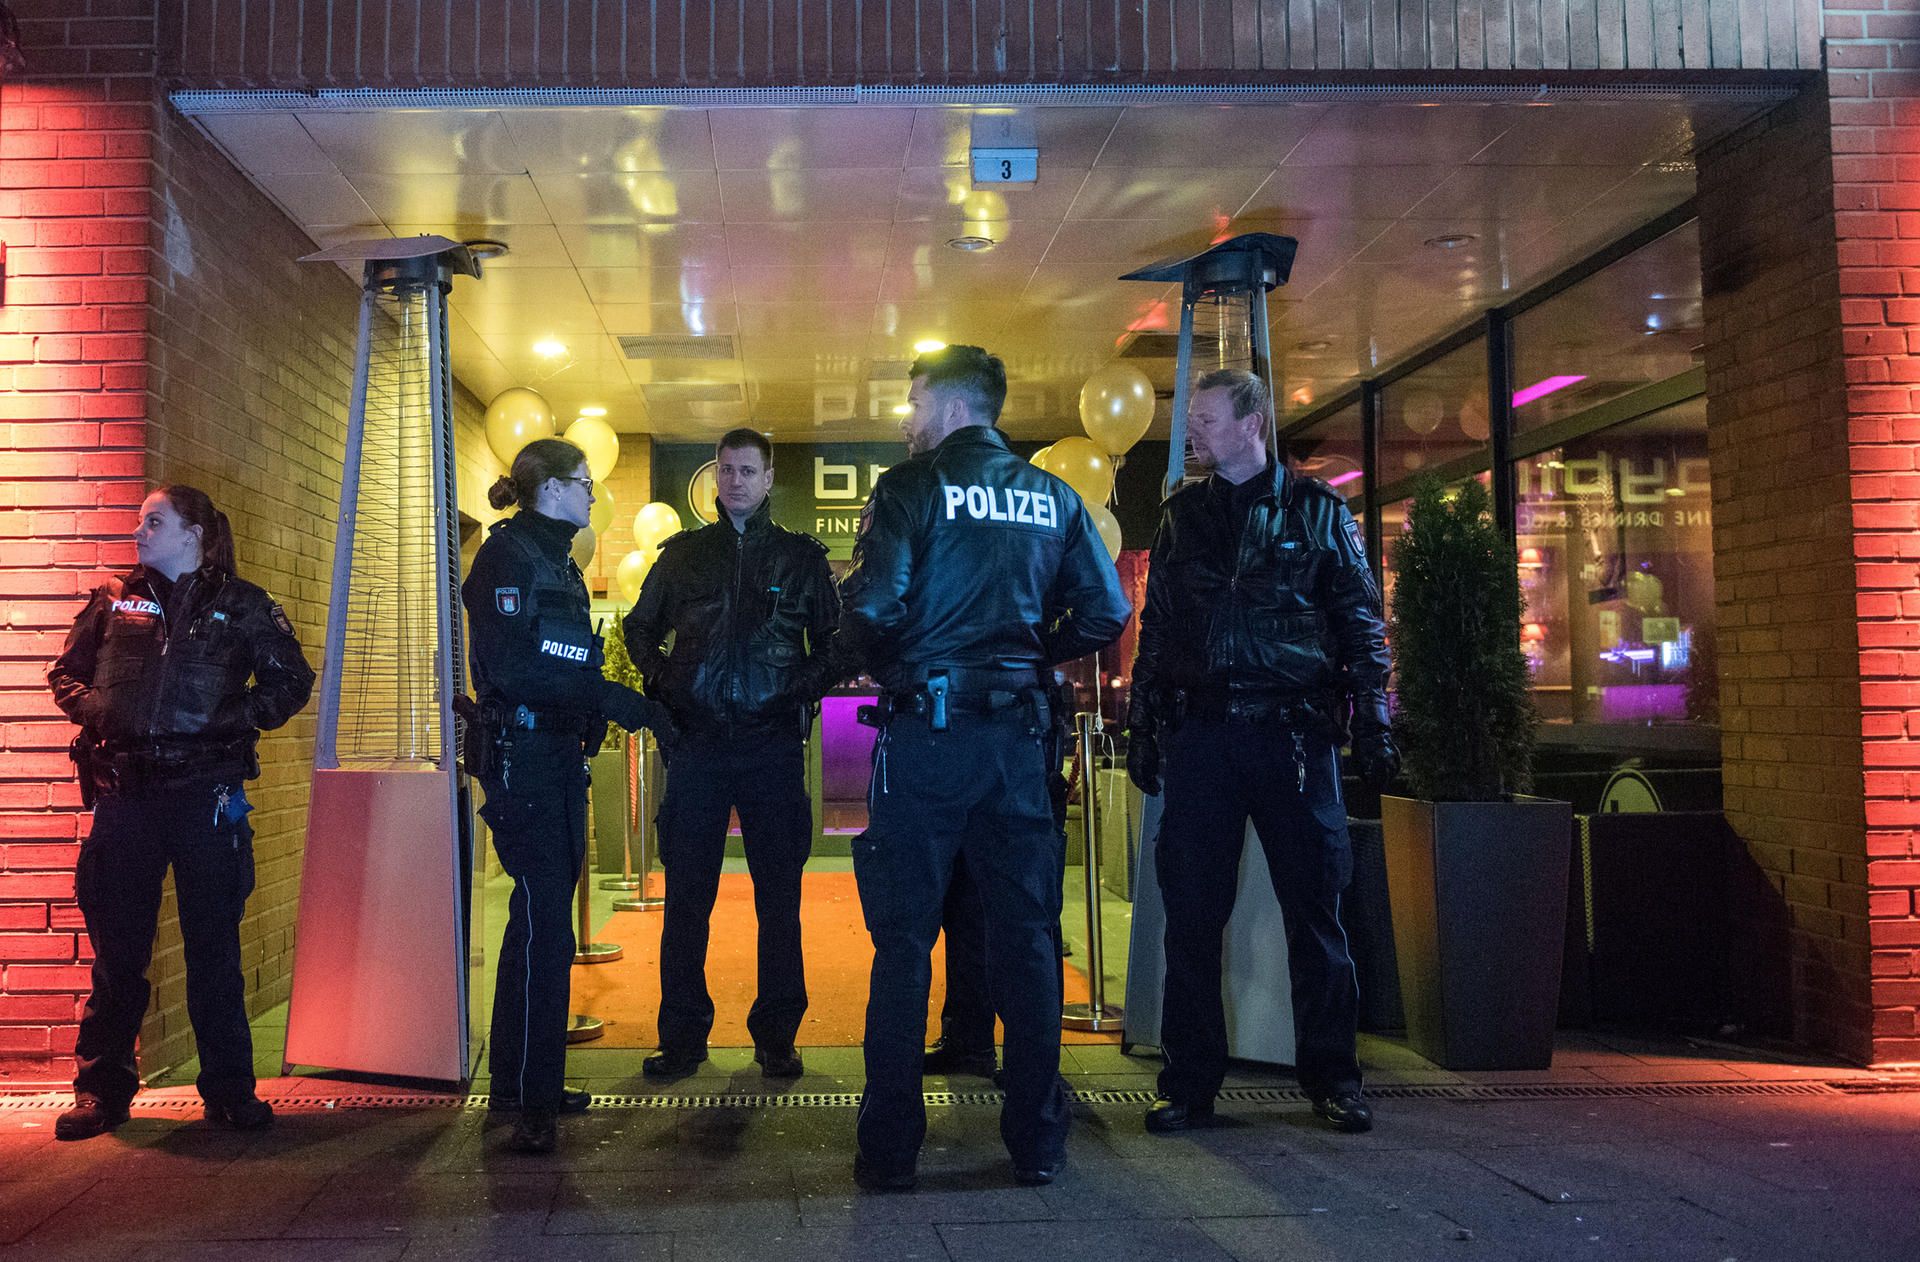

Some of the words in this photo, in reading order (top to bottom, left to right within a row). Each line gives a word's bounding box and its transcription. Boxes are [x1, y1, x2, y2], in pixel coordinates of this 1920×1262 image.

[1001, 159, 1012, 180] 3
[944, 485, 1057, 528] POLIZEI
[816, 517, 861, 533] FINE
[541, 640, 588, 661] POLIZEI
